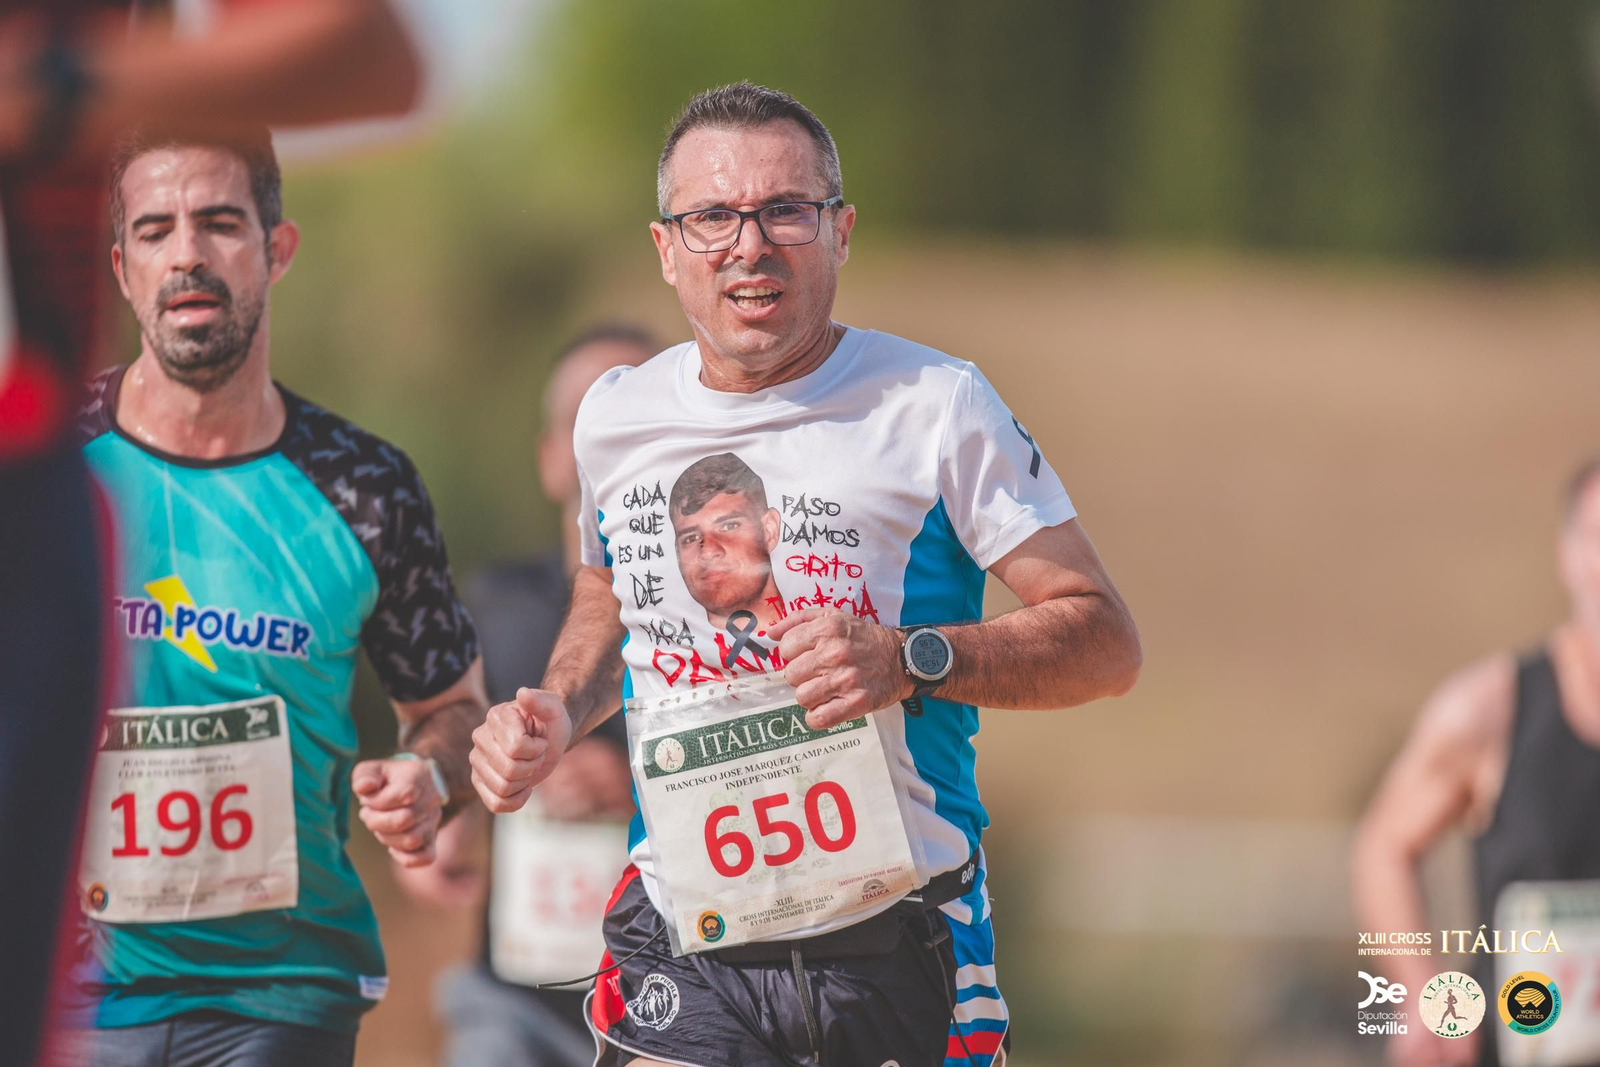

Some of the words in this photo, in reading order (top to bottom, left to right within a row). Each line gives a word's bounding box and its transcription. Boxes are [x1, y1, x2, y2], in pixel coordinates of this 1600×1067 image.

[623, 480, 666, 511] CADA
[782, 492, 841, 519] PASO
[629, 511, 665, 536] QUE
[781, 519, 861, 548] DAMOS
[618, 544, 633, 564] ES
[638, 542, 665, 561] UN
[629, 569, 665, 610] DE
[118, 601, 163, 637] TA
[175, 605, 311, 657] POWER
[122, 715, 229, 745] ITÁLICA
[697, 713, 809, 759] ITÁLICA
[665, 774, 718, 793] FRANCISCO
[719, 767, 744, 781] JOSE
[744, 756, 793, 775] MARQUEZ
[794, 738, 861, 762] CAMPANARIO
[703, 747, 756, 766] INTERNATIONAL
[758, 742, 778, 752] CROSS
[778, 734, 811, 748] COUNTRY
[725, 764, 803, 791] INDEPENDIENTE
[110, 785, 254, 858] 196
[704, 780, 857, 878] 650
[739, 913, 758, 923] CROSS
[757, 902, 804, 920] INTERNACIONAL
[772, 908, 805, 922] NOVIEMBRE
[814, 903, 827, 911] 2025
